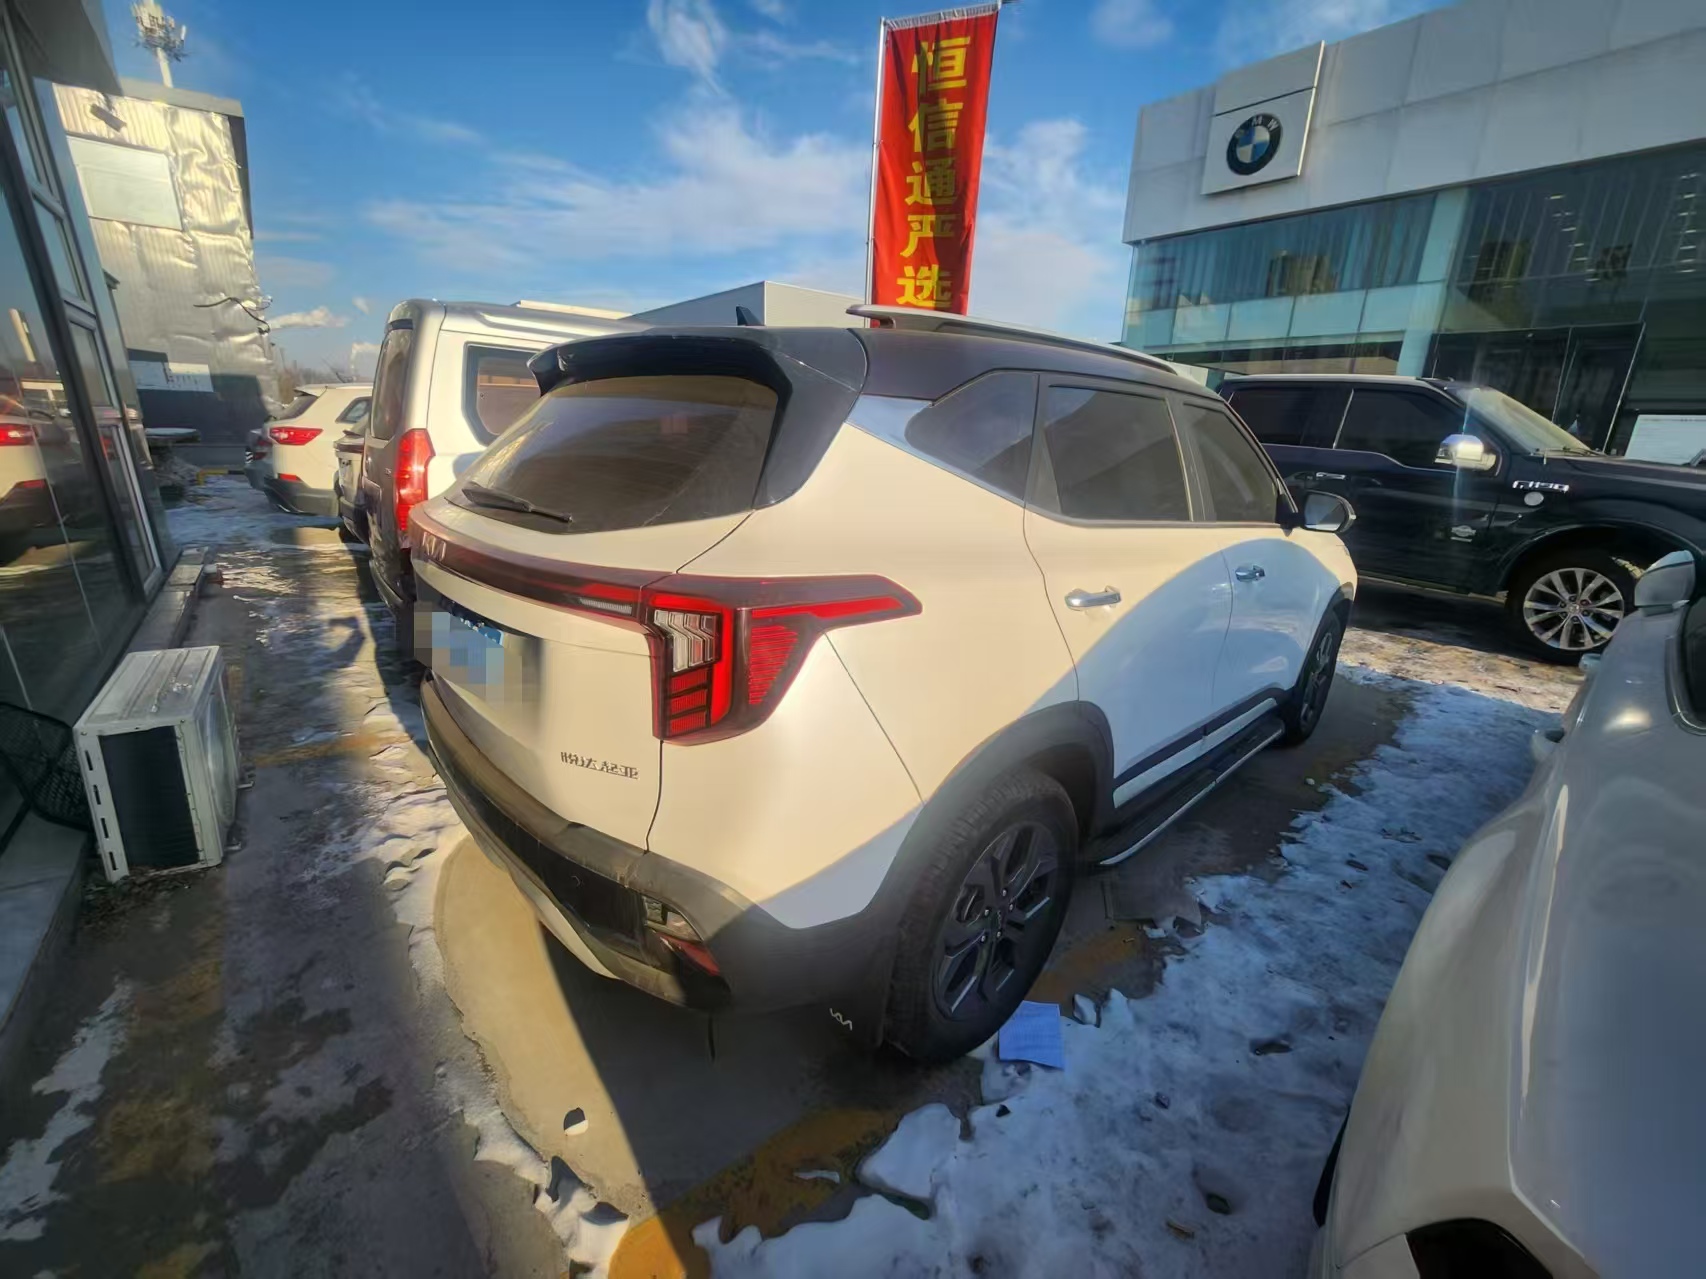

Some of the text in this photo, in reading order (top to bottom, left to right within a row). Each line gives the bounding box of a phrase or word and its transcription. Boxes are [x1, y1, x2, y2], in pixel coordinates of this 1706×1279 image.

[896, 36, 970, 308] 恒信通严选
[560, 751, 639, 780] 悦达起亚
